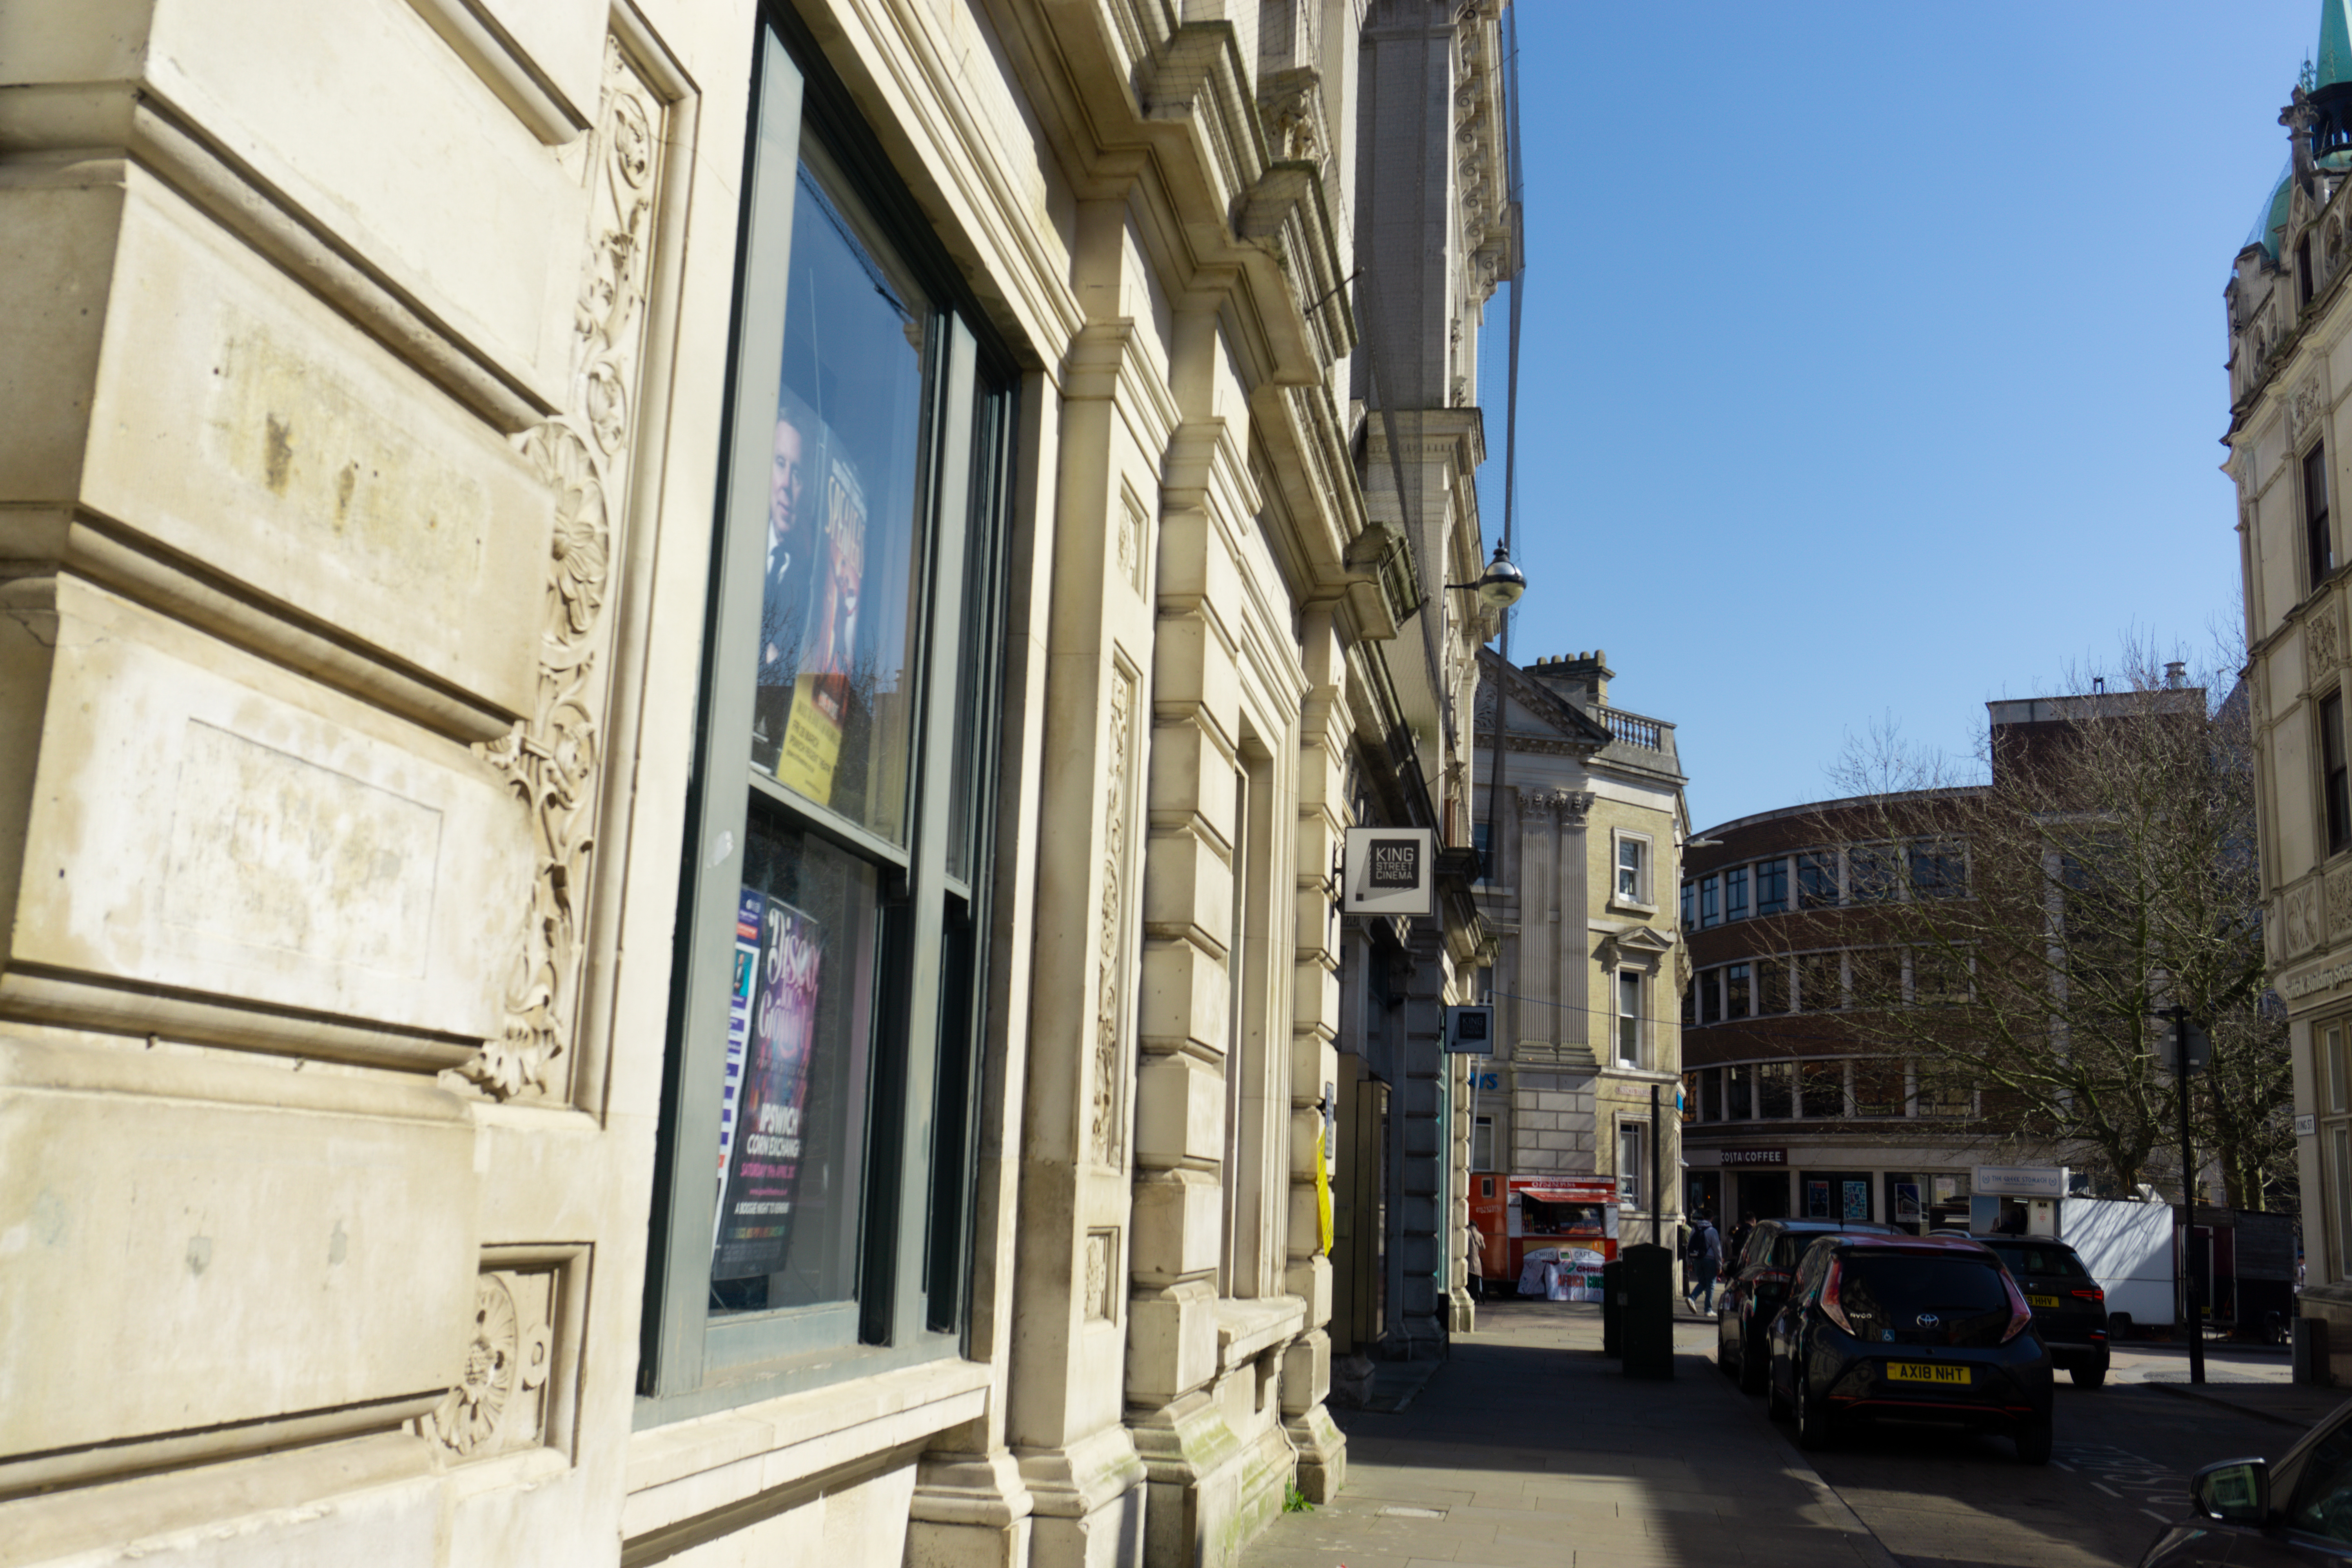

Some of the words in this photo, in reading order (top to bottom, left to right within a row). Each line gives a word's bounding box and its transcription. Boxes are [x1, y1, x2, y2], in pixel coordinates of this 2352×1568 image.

[1376, 847, 1414, 862] KING
[1376, 862, 1413, 871] STREET
[1376, 871, 1413, 880] CINEMA
[2285, 975, 2305, 1000] Suffolk
[2306, 968, 2333, 991] Building
[2334, 960, 2352, 983] Socie
[1462, 1017, 1483, 1025] KING
[759, 1102, 799, 1136] IPSWICH
[2297, 1120, 2307, 1131] KING
[746, 1133, 769, 1156] CORN
[768, 1134, 800, 1158] EXCHANG
[1721, 1152, 1742, 1163] COSTA
[1745, 1151, 1781, 1162] COFFEE
[1558, 1274, 1584, 1289] AFRICA
[1586, 1274, 1604, 1289] CUIS
[2035, 1296, 2052, 1305] HHV
[1900, 1364, 1931, 1379] AX18
[1935, 1367, 1963, 1381] NHT
